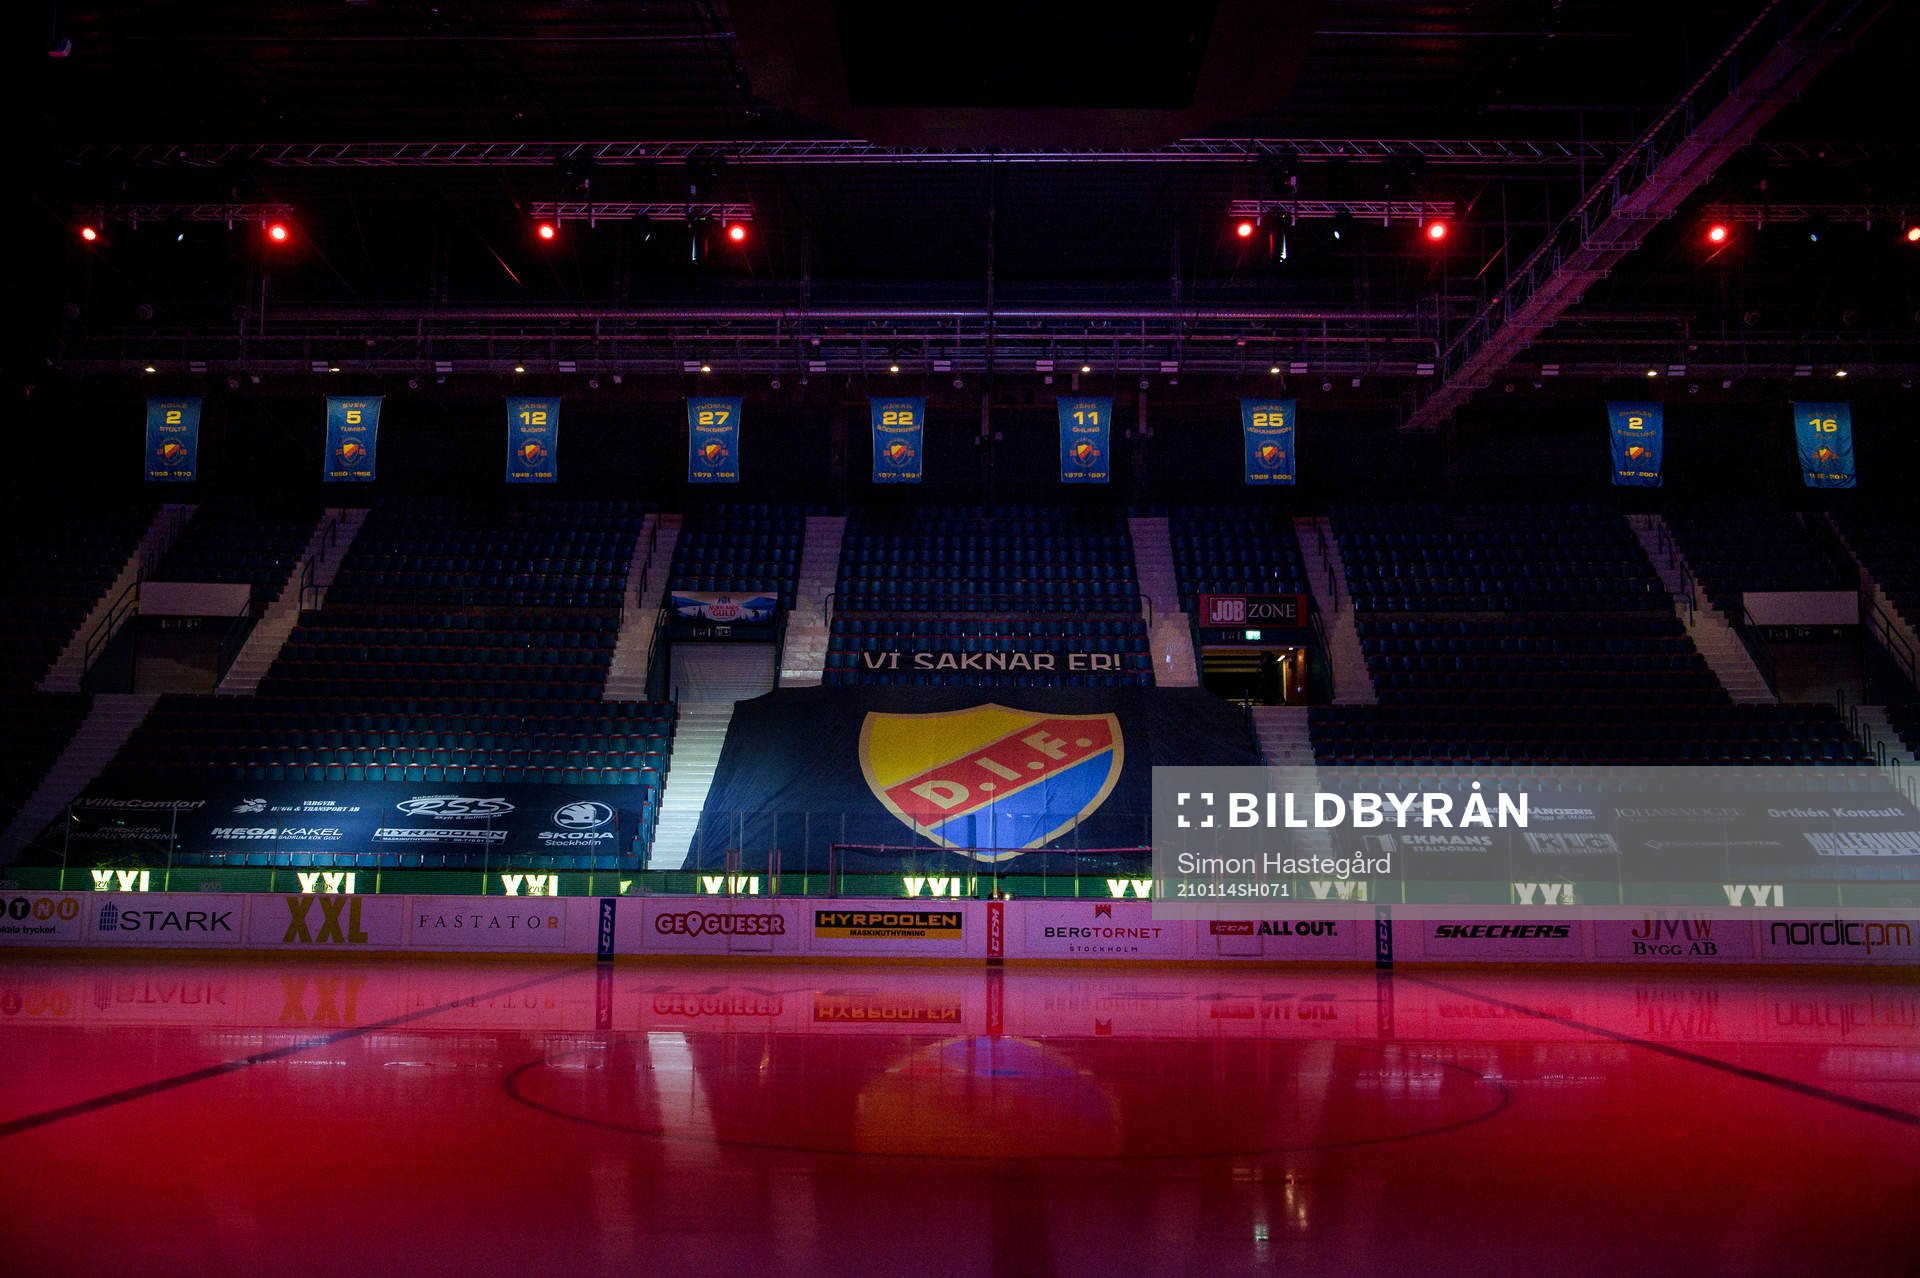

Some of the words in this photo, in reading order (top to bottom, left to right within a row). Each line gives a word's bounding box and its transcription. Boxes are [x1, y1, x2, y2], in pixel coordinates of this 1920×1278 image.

[166, 410, 182, 425] 2
[346, 410, 361, 424] 5
[520, 411, 547, 425] 12
[698, 411, 730, 425] 27
[882, 411, 913, 425] 22
[1072, 411, 1099, 425] 11
[1252, 412, 1284, 426] 25
[1628, 417, 1643, 430] 2
[1808, 418, 1838, 433] 16
[712, 609, 737, 617] GULD
[1212, 600, 1245, 621] JOB
[1247, 604, 1297, 618] ZONE
[863, 652, 900, 669] VI
[913, 652, 1057, 671] SAKNAR
[1067, 652, 1121, 671] ER!
[85, 799, 206, 809] VillaComfort
[1767, 807, 1830, 818] Orthén
[1832, 807, 1906, 817] Konsult
[210, 827, 278, 836] MEGA
[281, 827, 343, 836] KAKEL
[1401, 834, 1493, 846] EKMANS
[120, 911, 232, 931] STARK
[282, 896, 369, 943] XXL
[419, 915, 559, 929] FASTATOR
[819, 912, 959, 928] HYRPOOLEN
[1631, 912, 1714, 941] JMW
[850, 930, 926, 938] MASKINUTHYRNING
[1044, 927, 1161, 939] BERGTORNET
[1257, 921, 1293, 936] ALL
[1295, 921, 1338, 937] OUT.
[1434, 924, 1572, 939] SKECHERS
[1688, 942, 1718, 956] AB
